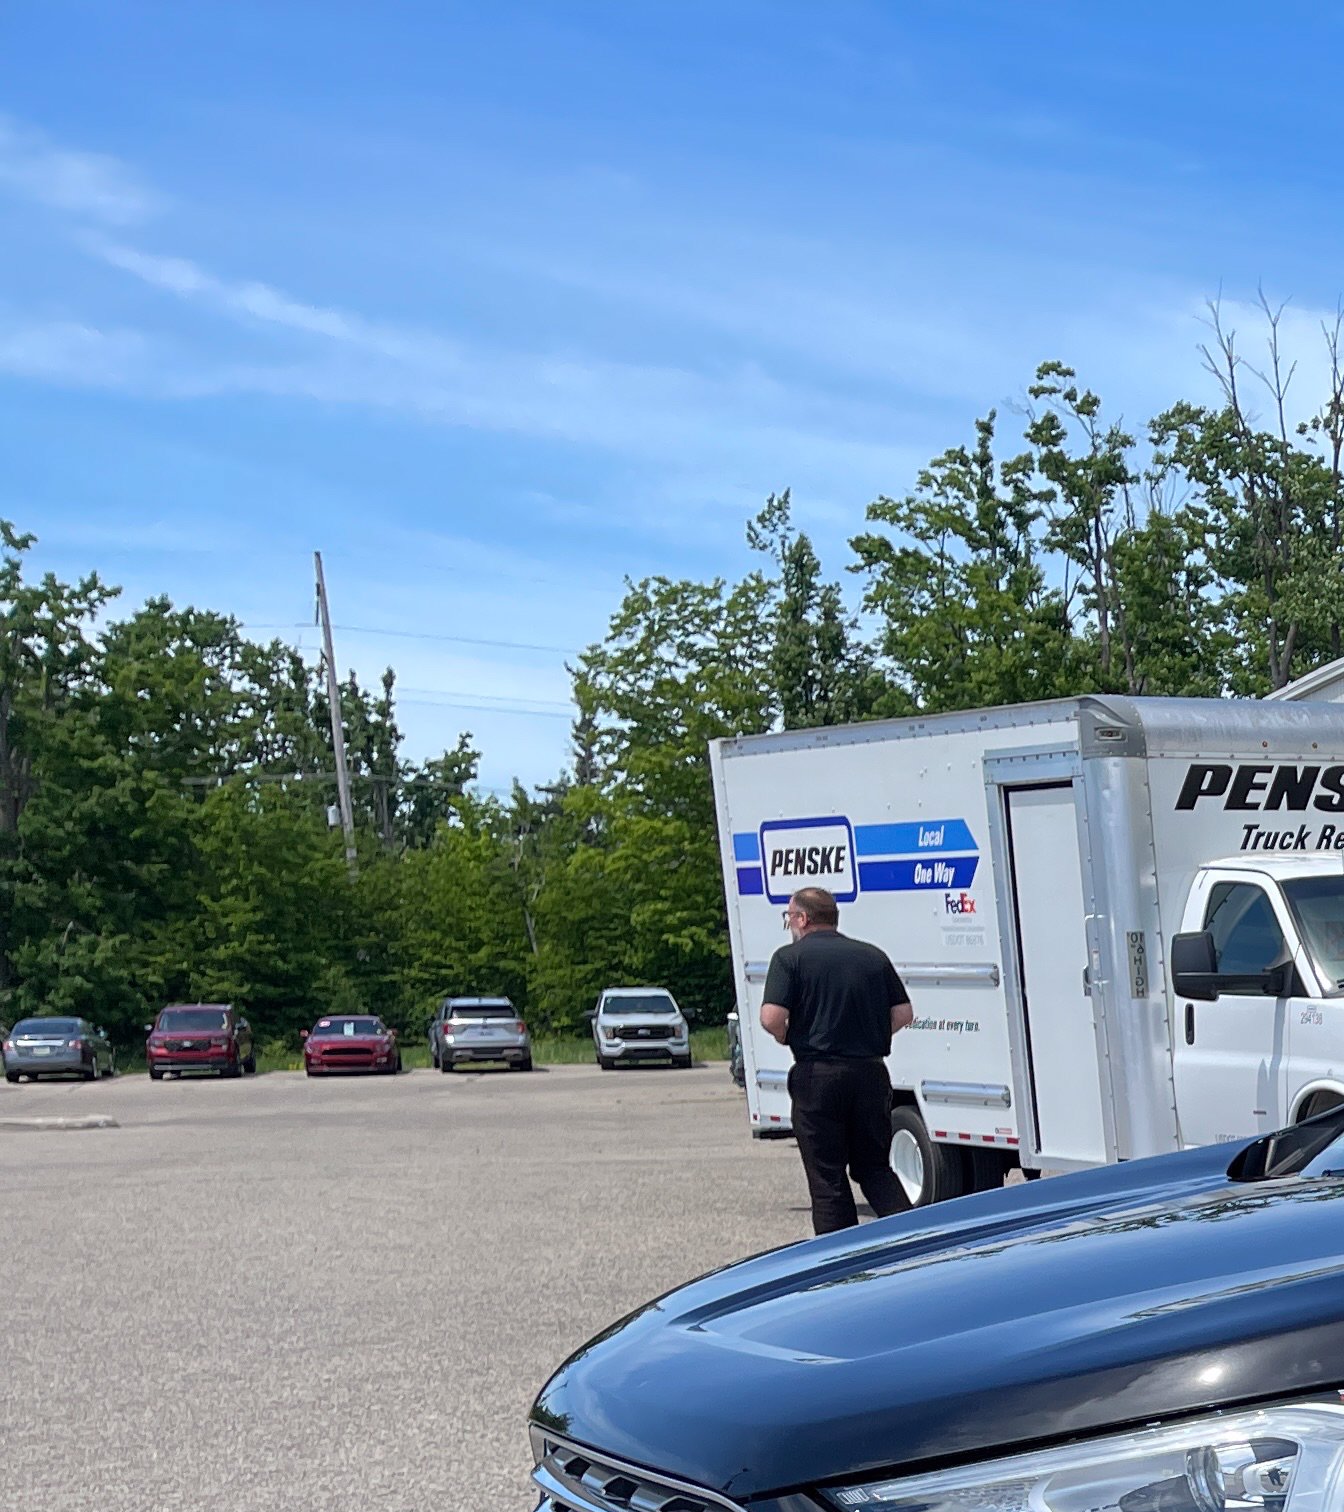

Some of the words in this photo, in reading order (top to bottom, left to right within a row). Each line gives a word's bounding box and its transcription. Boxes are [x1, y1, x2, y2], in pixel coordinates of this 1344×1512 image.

[918, 825, 944, 847] Local
[1240, 824, 1311, 850] Truck
[770, 845, 847, 877] PENSKE
[914, 863, 932, 885] One
[934, 862, 955, 887] Way
[945, 893, 976, 914] FedEx
[939, 1020, 945, 1031] at
[947, 1020, 963, 1034] every
